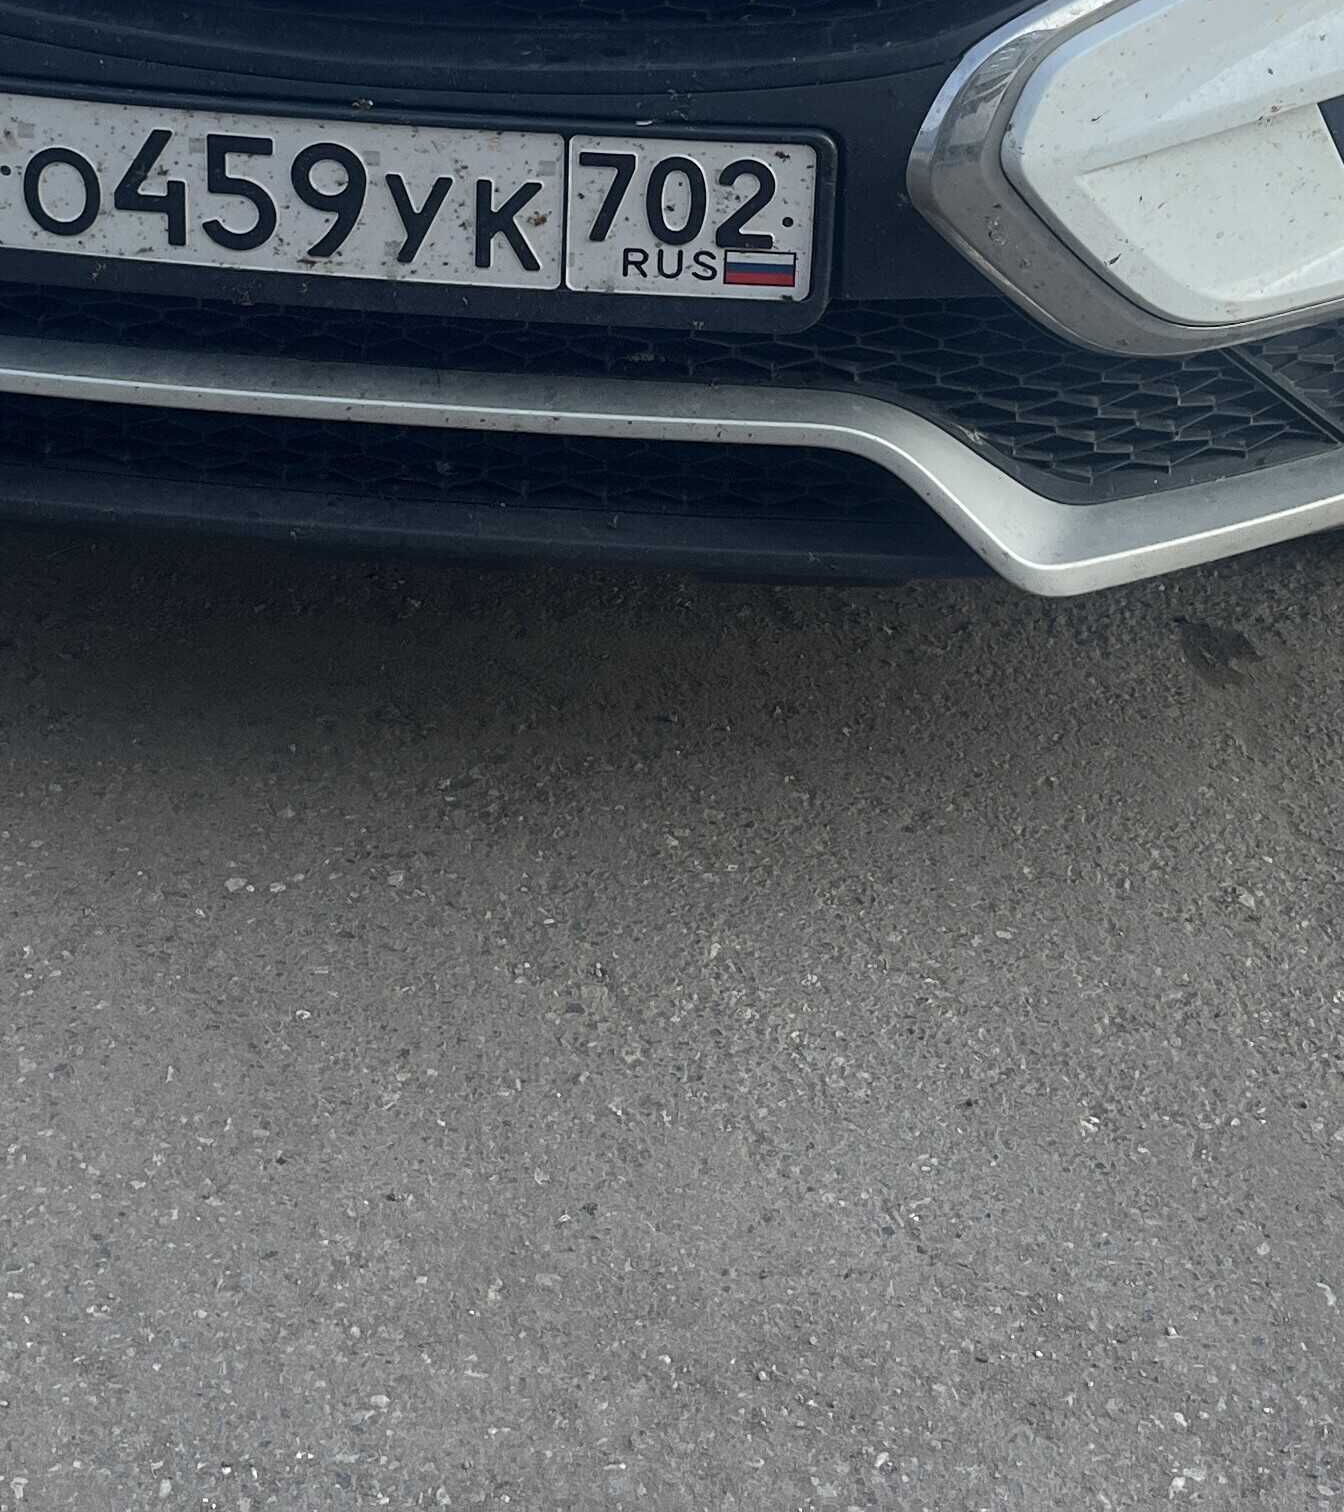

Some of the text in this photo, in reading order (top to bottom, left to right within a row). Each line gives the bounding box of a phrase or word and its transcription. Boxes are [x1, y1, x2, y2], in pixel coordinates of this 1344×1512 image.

[22, 129, 777, 272] О459УК 702
[622, 247, 718, 281] RUS
